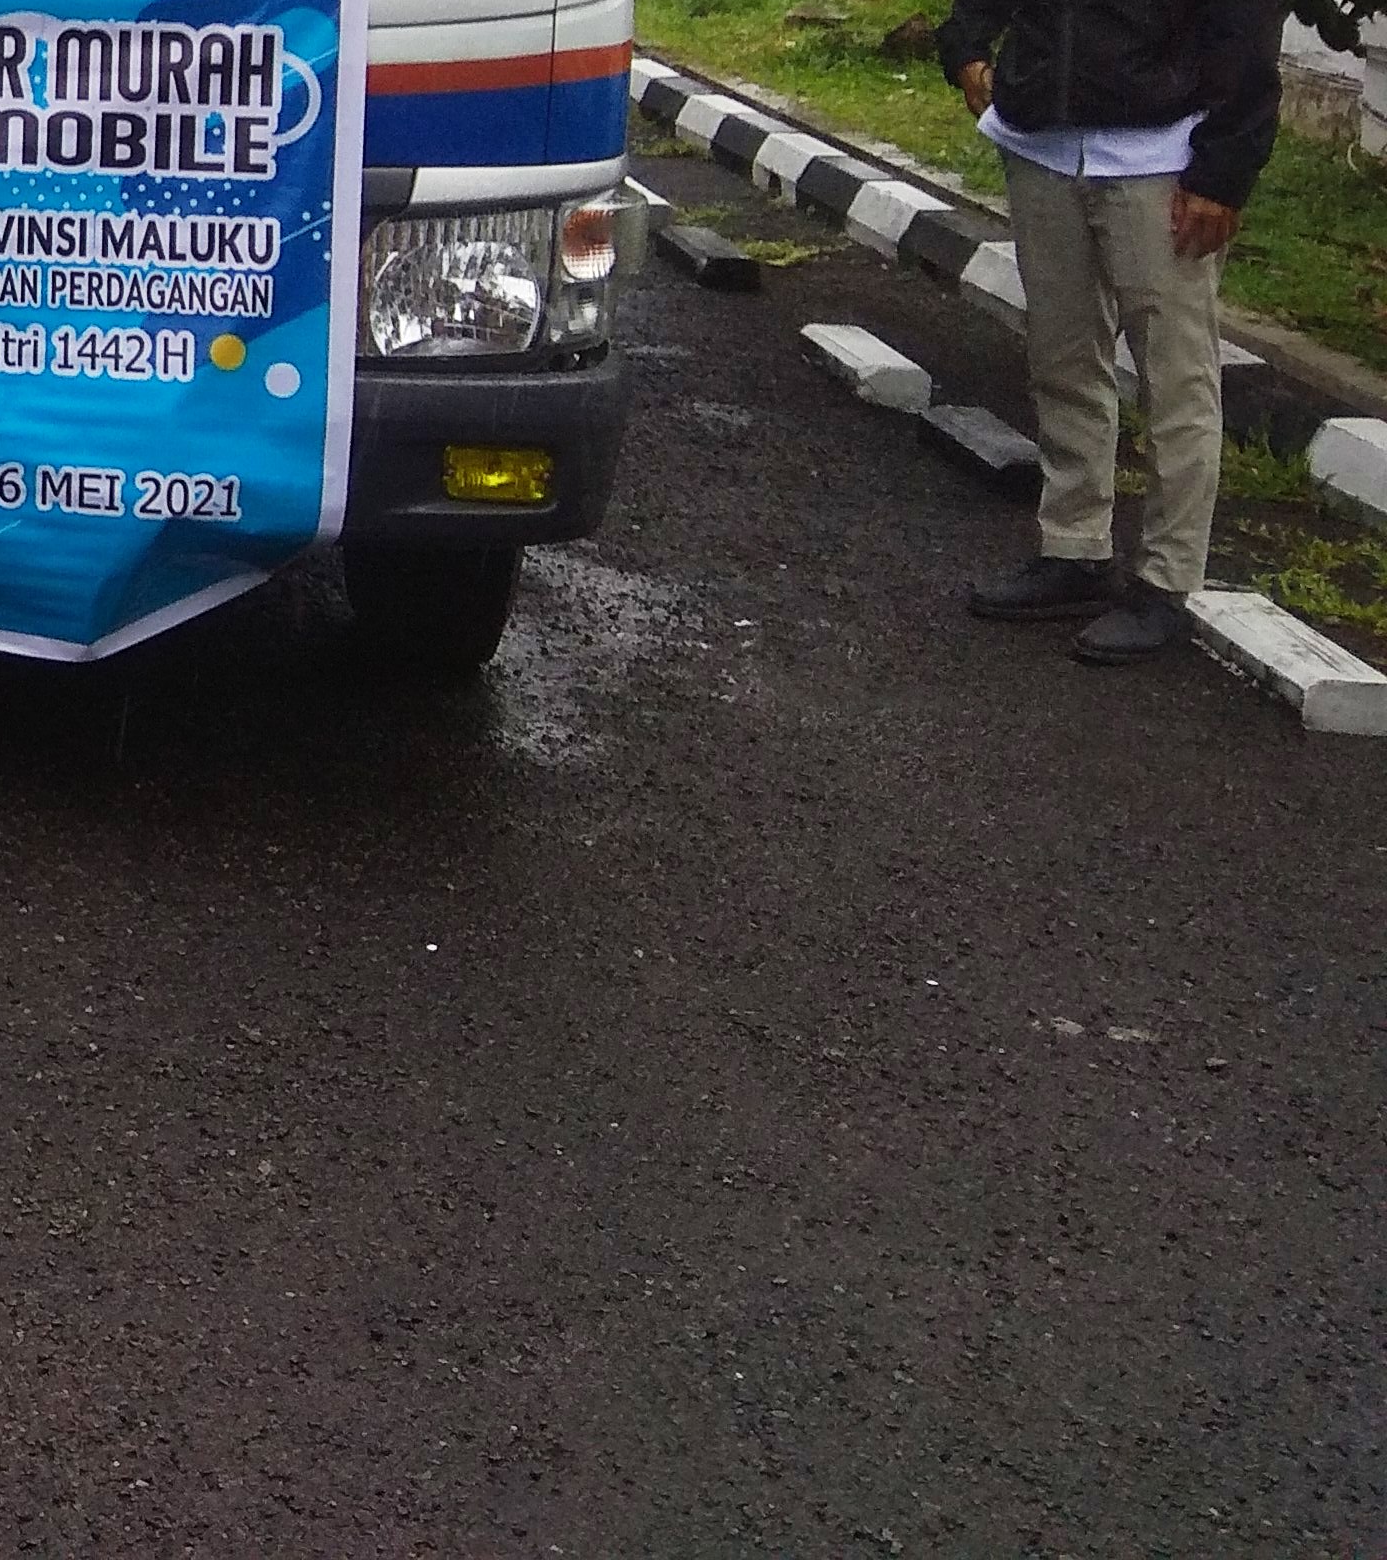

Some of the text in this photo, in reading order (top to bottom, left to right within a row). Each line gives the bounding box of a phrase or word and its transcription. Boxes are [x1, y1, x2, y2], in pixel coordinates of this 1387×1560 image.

[54, 28, 275, 107] MURAH
[101, 218, 274, 265] MALUKU
[50, 269, 270, 313] PERDAGANGAN
[55, 331, 147, 374] 1442
[162, 336, 189, 376] H
[41, 469, 120, 512] MEI
[139, 476, 238, 517] 2021
